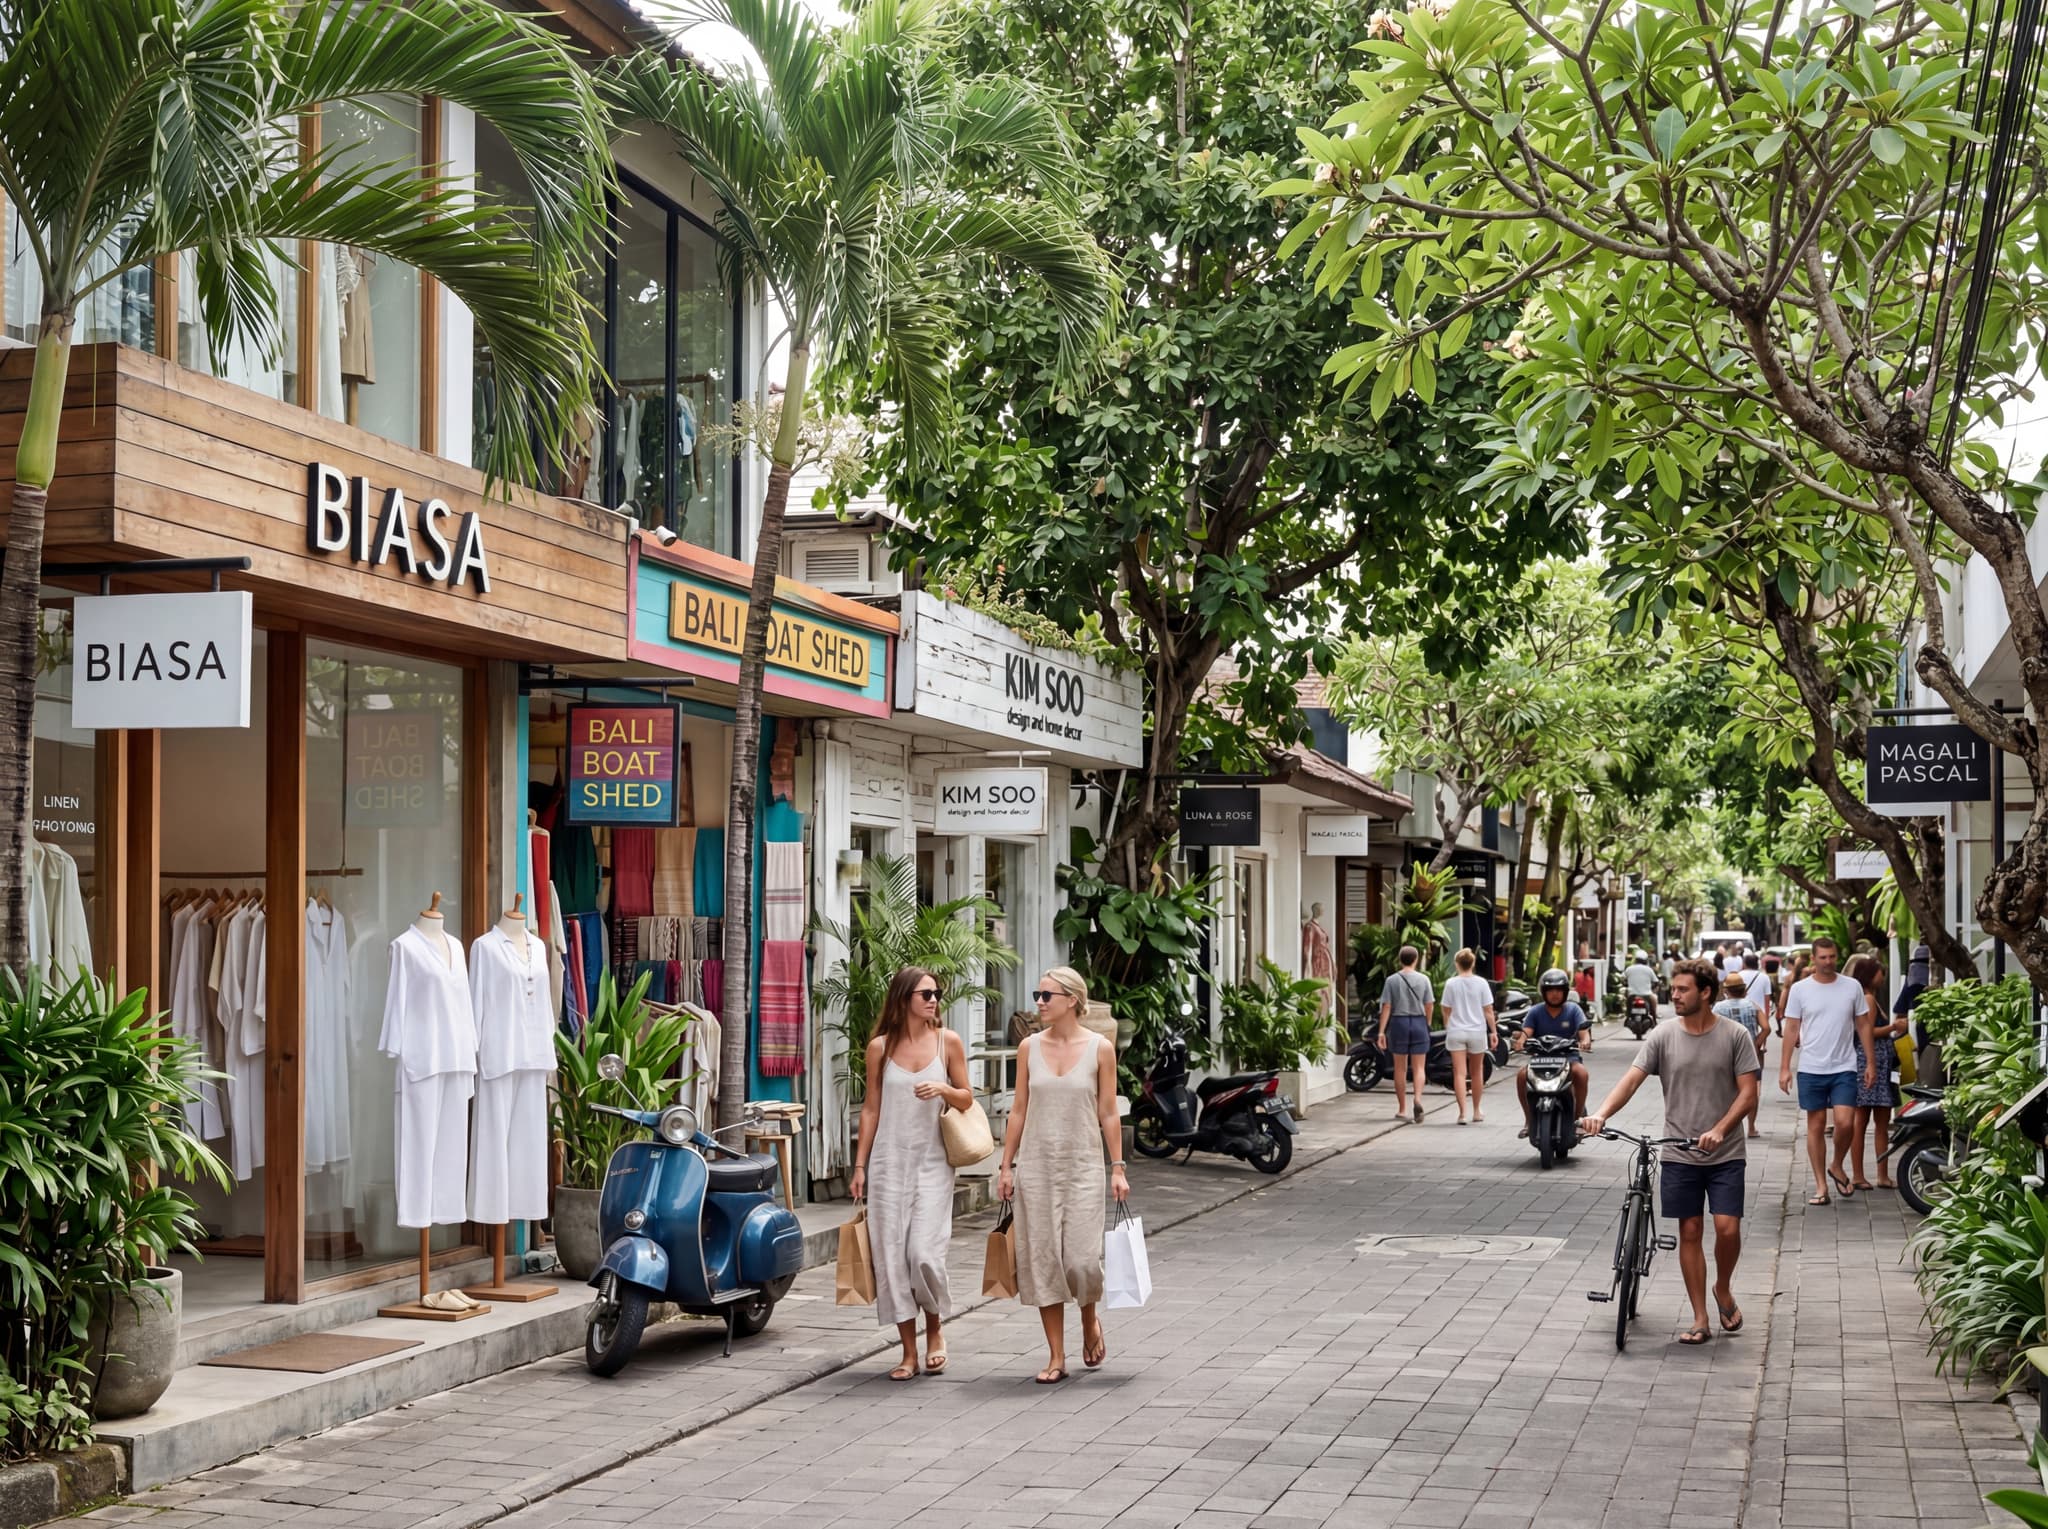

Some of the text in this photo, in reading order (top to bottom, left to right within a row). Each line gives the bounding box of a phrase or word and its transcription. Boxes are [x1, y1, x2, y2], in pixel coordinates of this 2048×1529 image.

[307, 461, 491, 594] BIASA
[684, 591, 864, 678] BALI OAT SHED
[86, 640, 227, 682] BIASA
[1005, 652, 1084, 717] KIM SOO
[589, 719, 653, 744] BALI
[583, 751, 661, 776] BOAT
[1880, 742, 1976, 762] MAGALI
[1881, 764, 1979, 784] PASCAL
[43, 795, 79, 809] LINEN
[583, 783, 662, 808] SHED
[942, 785, 1036, 804] KIM SOO
[1185, 811, 1253, 820] LUNA & ROSE
